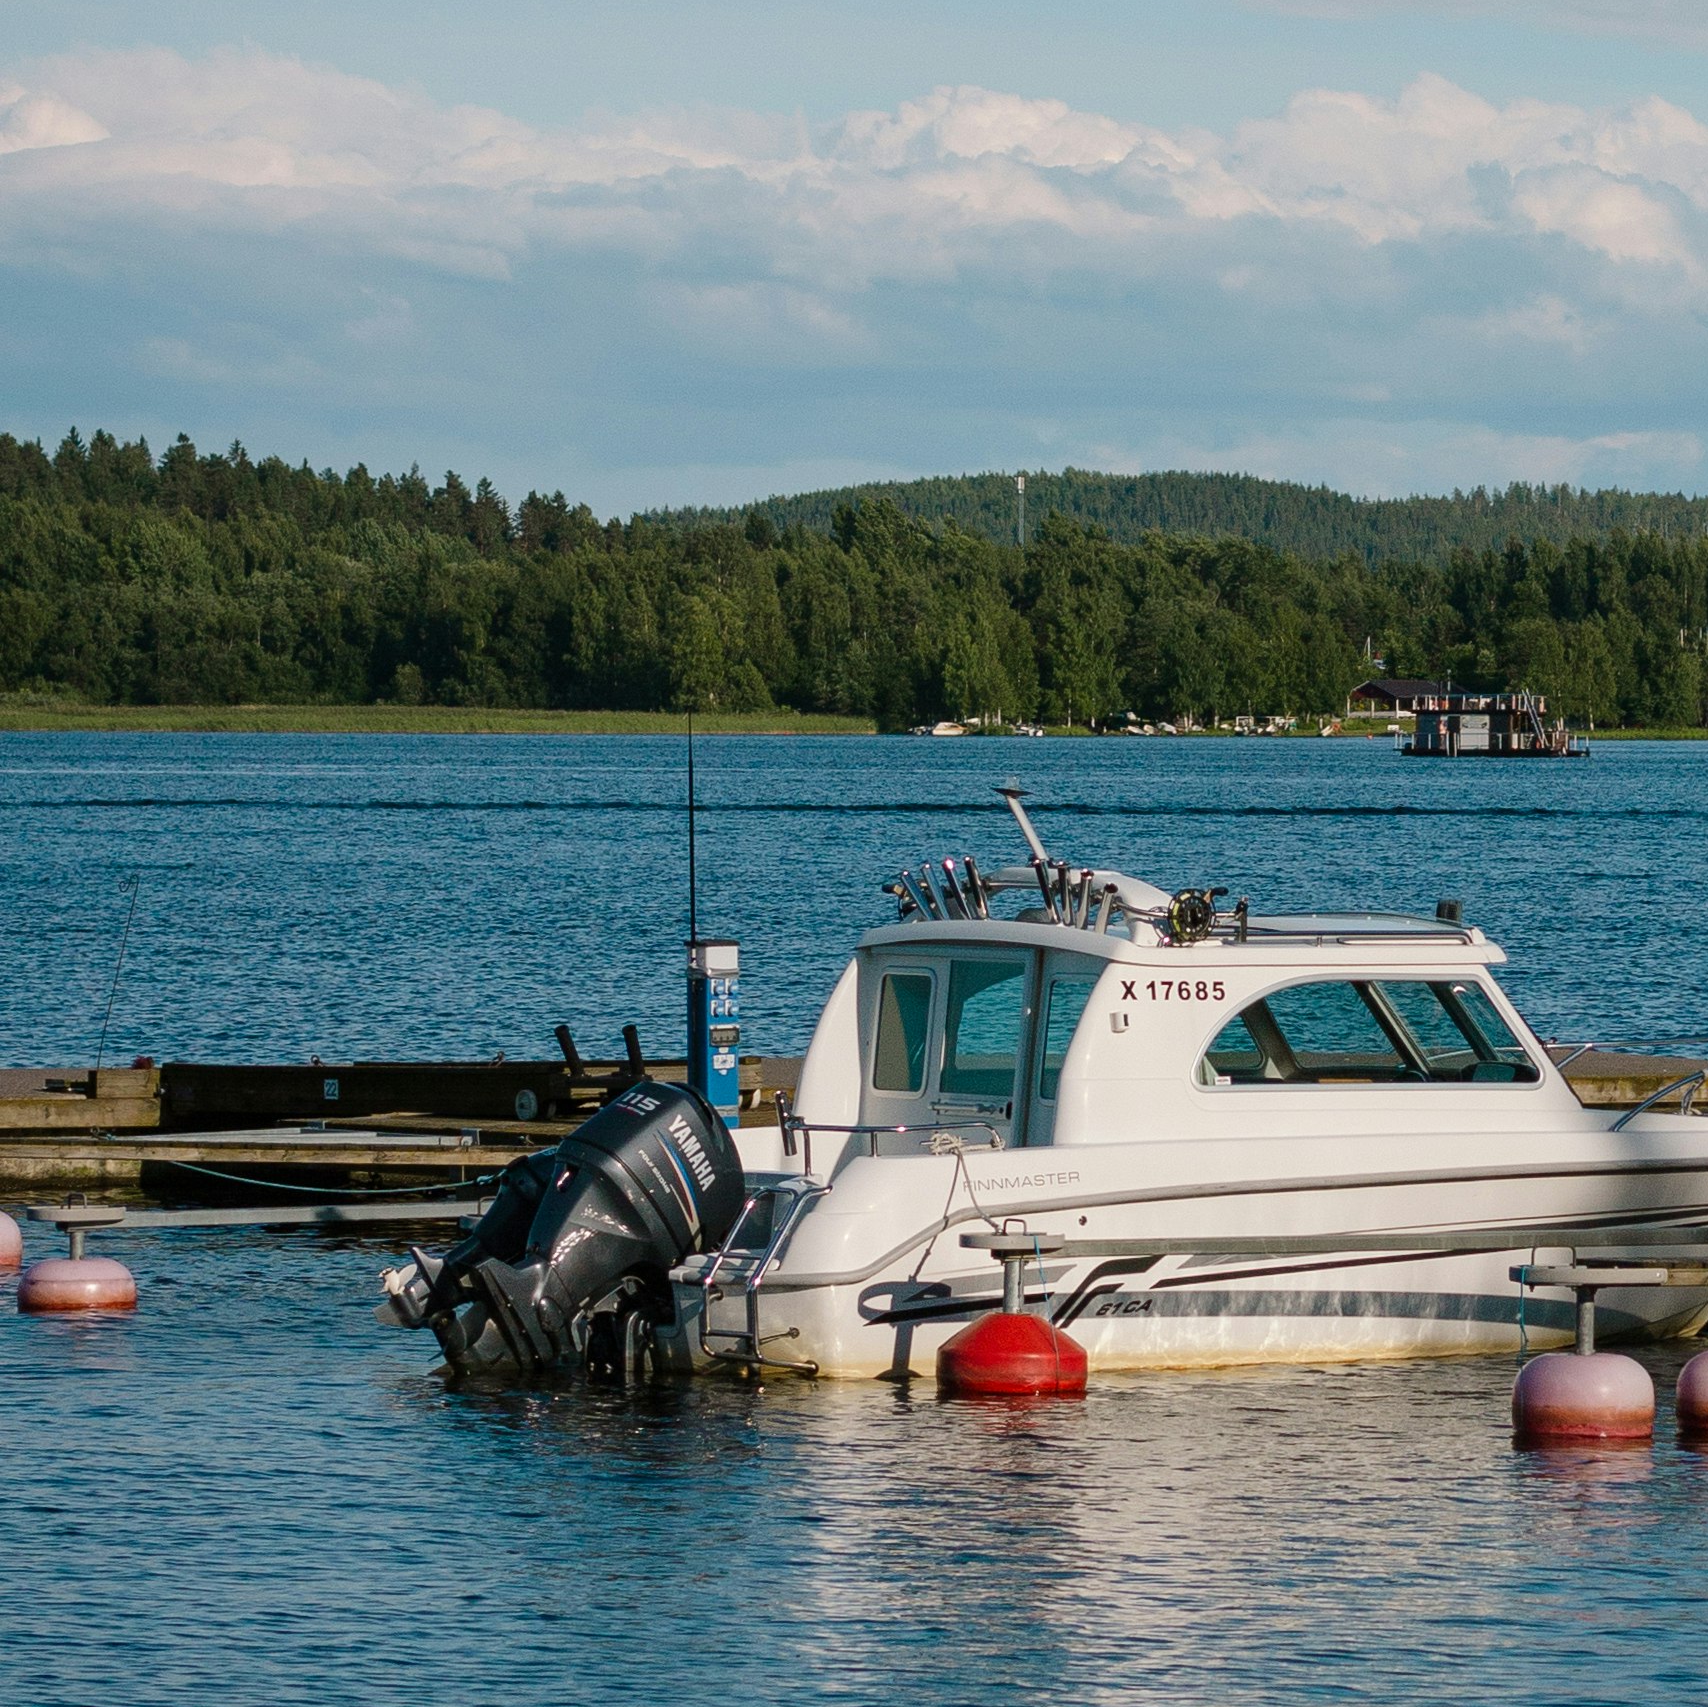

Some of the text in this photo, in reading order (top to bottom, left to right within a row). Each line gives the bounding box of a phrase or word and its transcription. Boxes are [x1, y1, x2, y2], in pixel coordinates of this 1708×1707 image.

[1120, 980, 1226, 1001] X 17685
[621, 1092, 661, 1111] 115
[668, 1113, 716, 1192] YAMAHA
[962, 1171, 1081, 1192] FINNMASTER
[1122, 1298, 1153, 1314] CA
